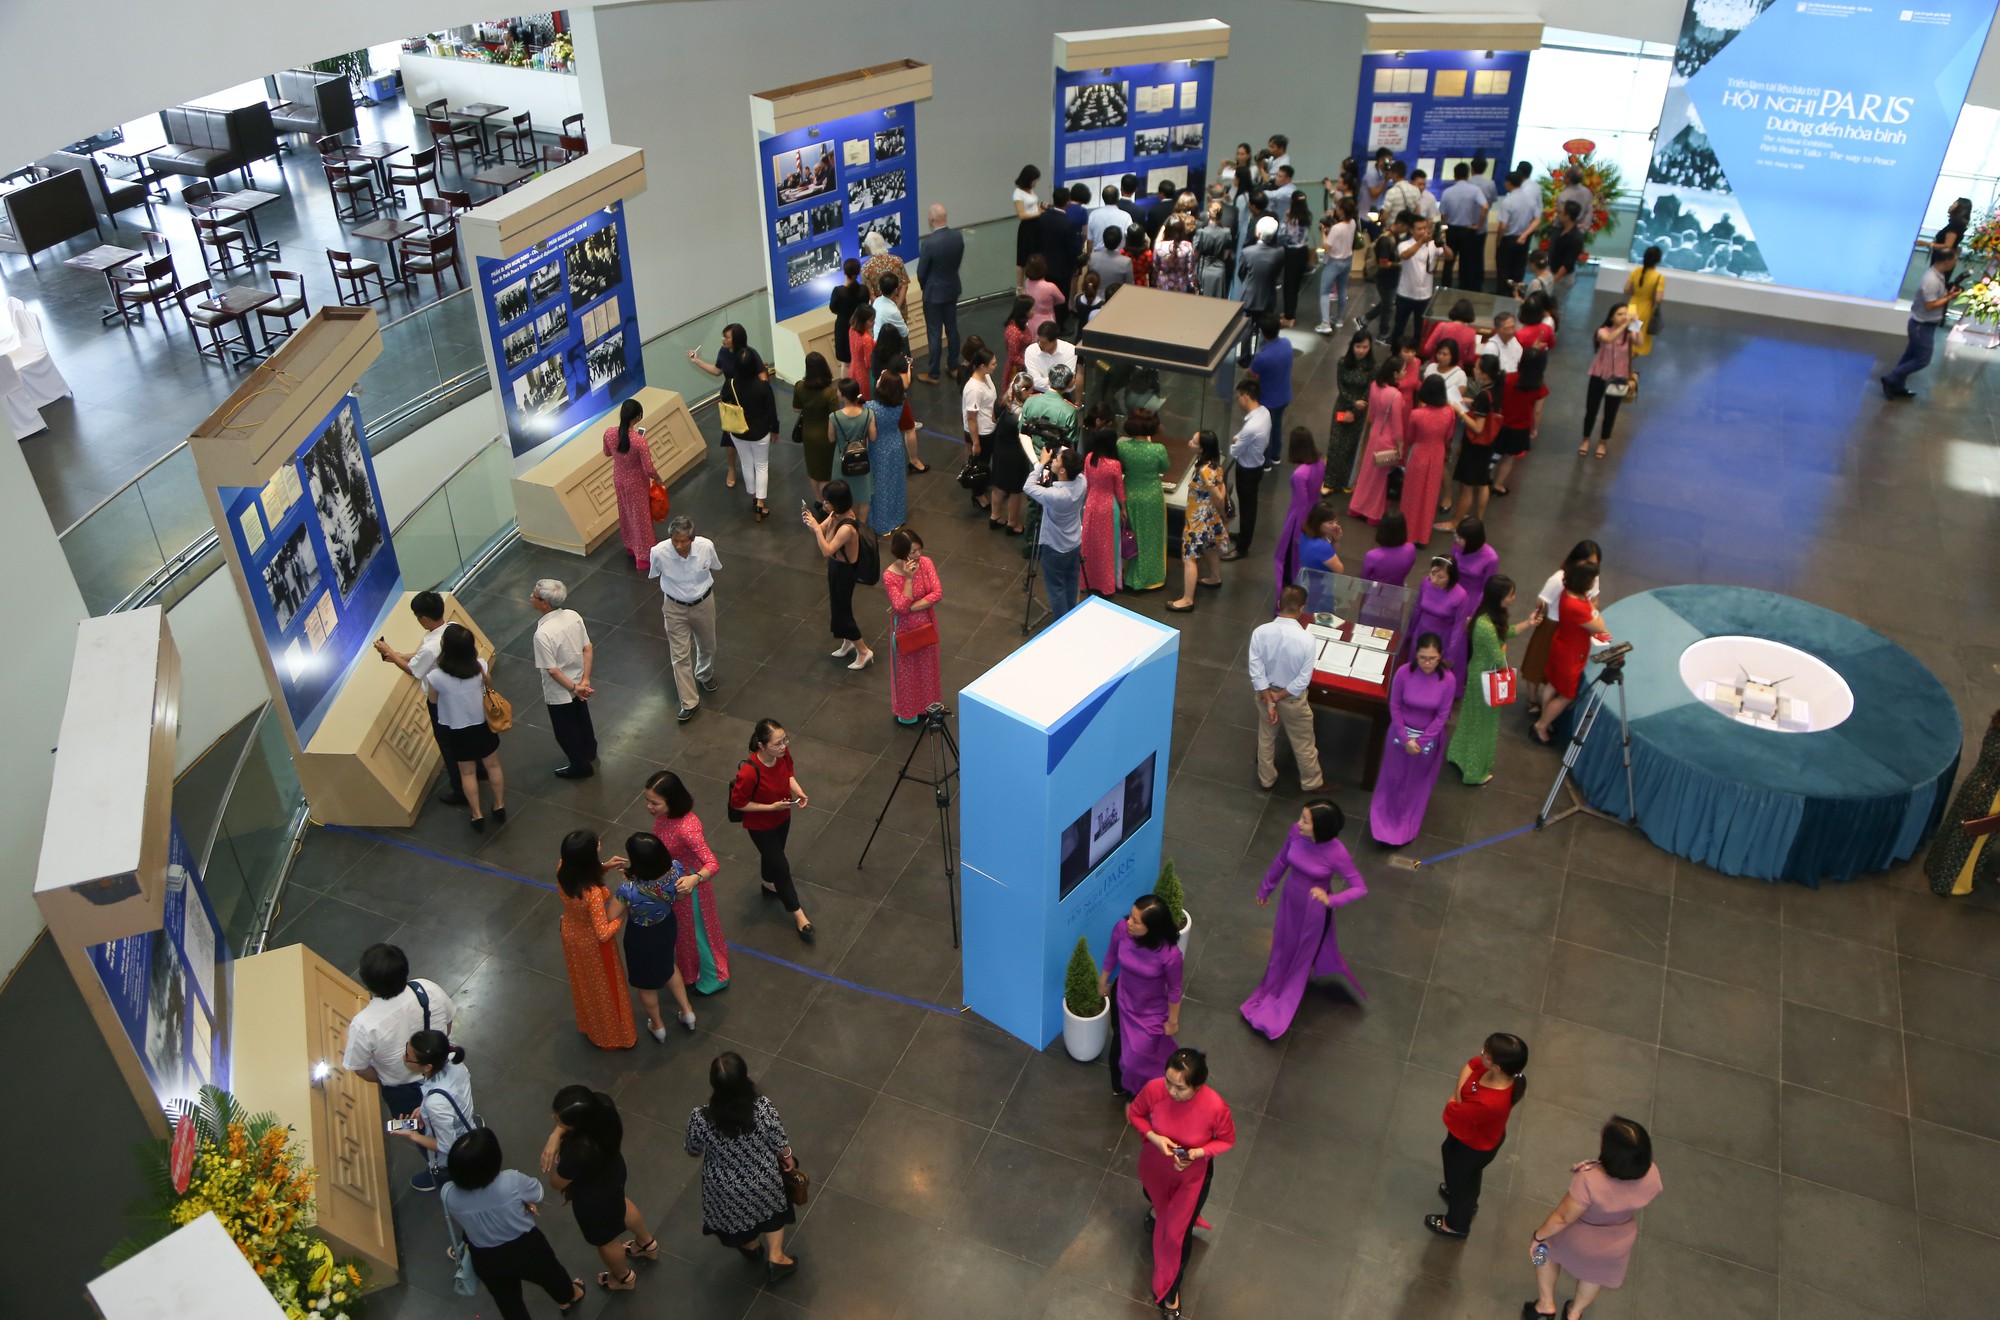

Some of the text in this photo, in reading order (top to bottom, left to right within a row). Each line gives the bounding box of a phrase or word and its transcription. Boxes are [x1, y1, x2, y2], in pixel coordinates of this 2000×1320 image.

[1722, 89, 1914, 124] HỘI NGHỊ PARIS
[1829, 151, 1843, 161] The
